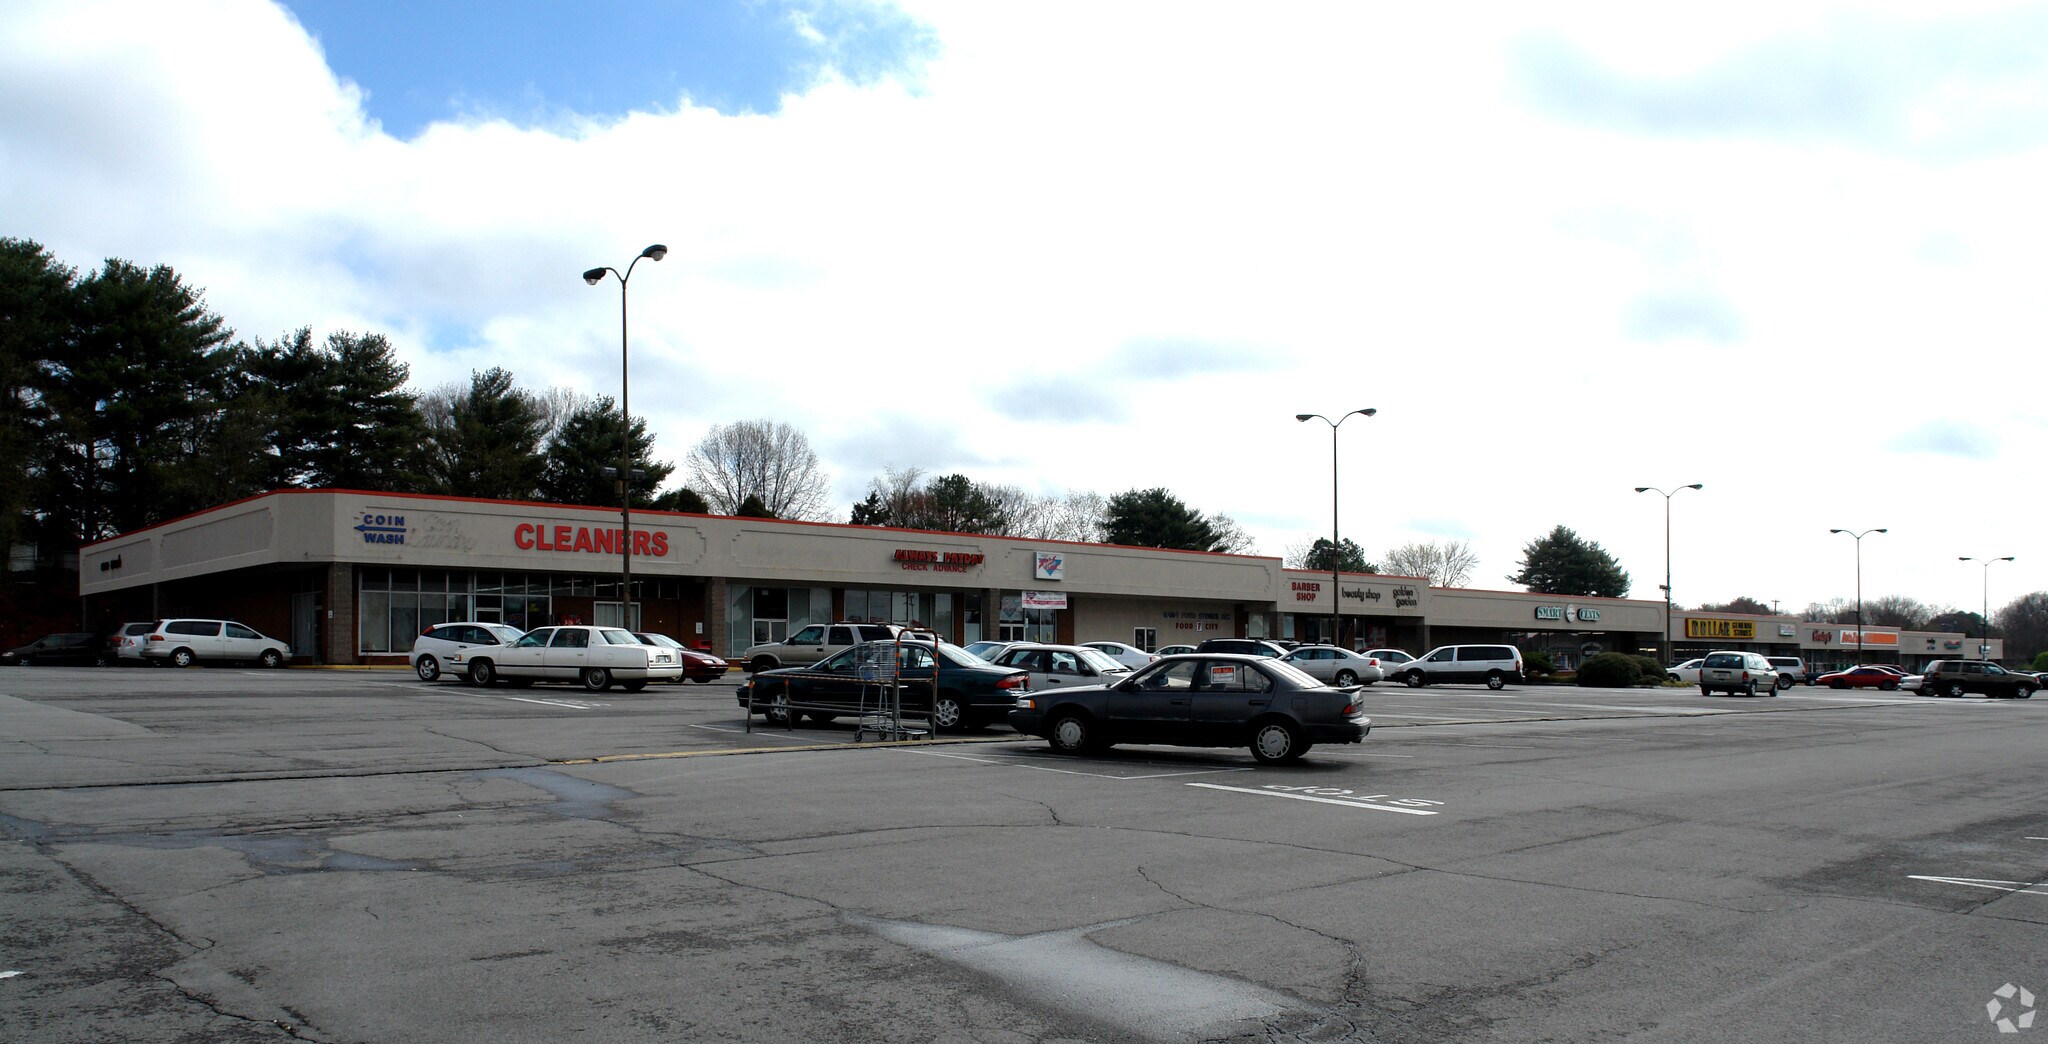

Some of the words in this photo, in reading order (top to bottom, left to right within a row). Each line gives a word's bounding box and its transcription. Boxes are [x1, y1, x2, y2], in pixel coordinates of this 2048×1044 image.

[363, 514, 405, 526] COIN
[363, 533, 405, 545] WASH
[514, 523, 669, 557] CLEANERS
[894, 549, 938, 561] ALWAYS
[943, 552, 985, 565] PAYDAY
[902, 563, 928, 571] CHECK
[933, 564, 967, 573] ADVANCE
[1291, 582, 1320, 592] BARBER
[1296, 592, 1316, 601] SHOP
[1365, 588, 1381, 602] shop
[1538, 606, 1563, 618] SMART
[1580, 608, 1600, 619] CENTS
[1175, 622, 1193, 630] FOOD
[1691, 620, 1731, 637] DOLLAR
